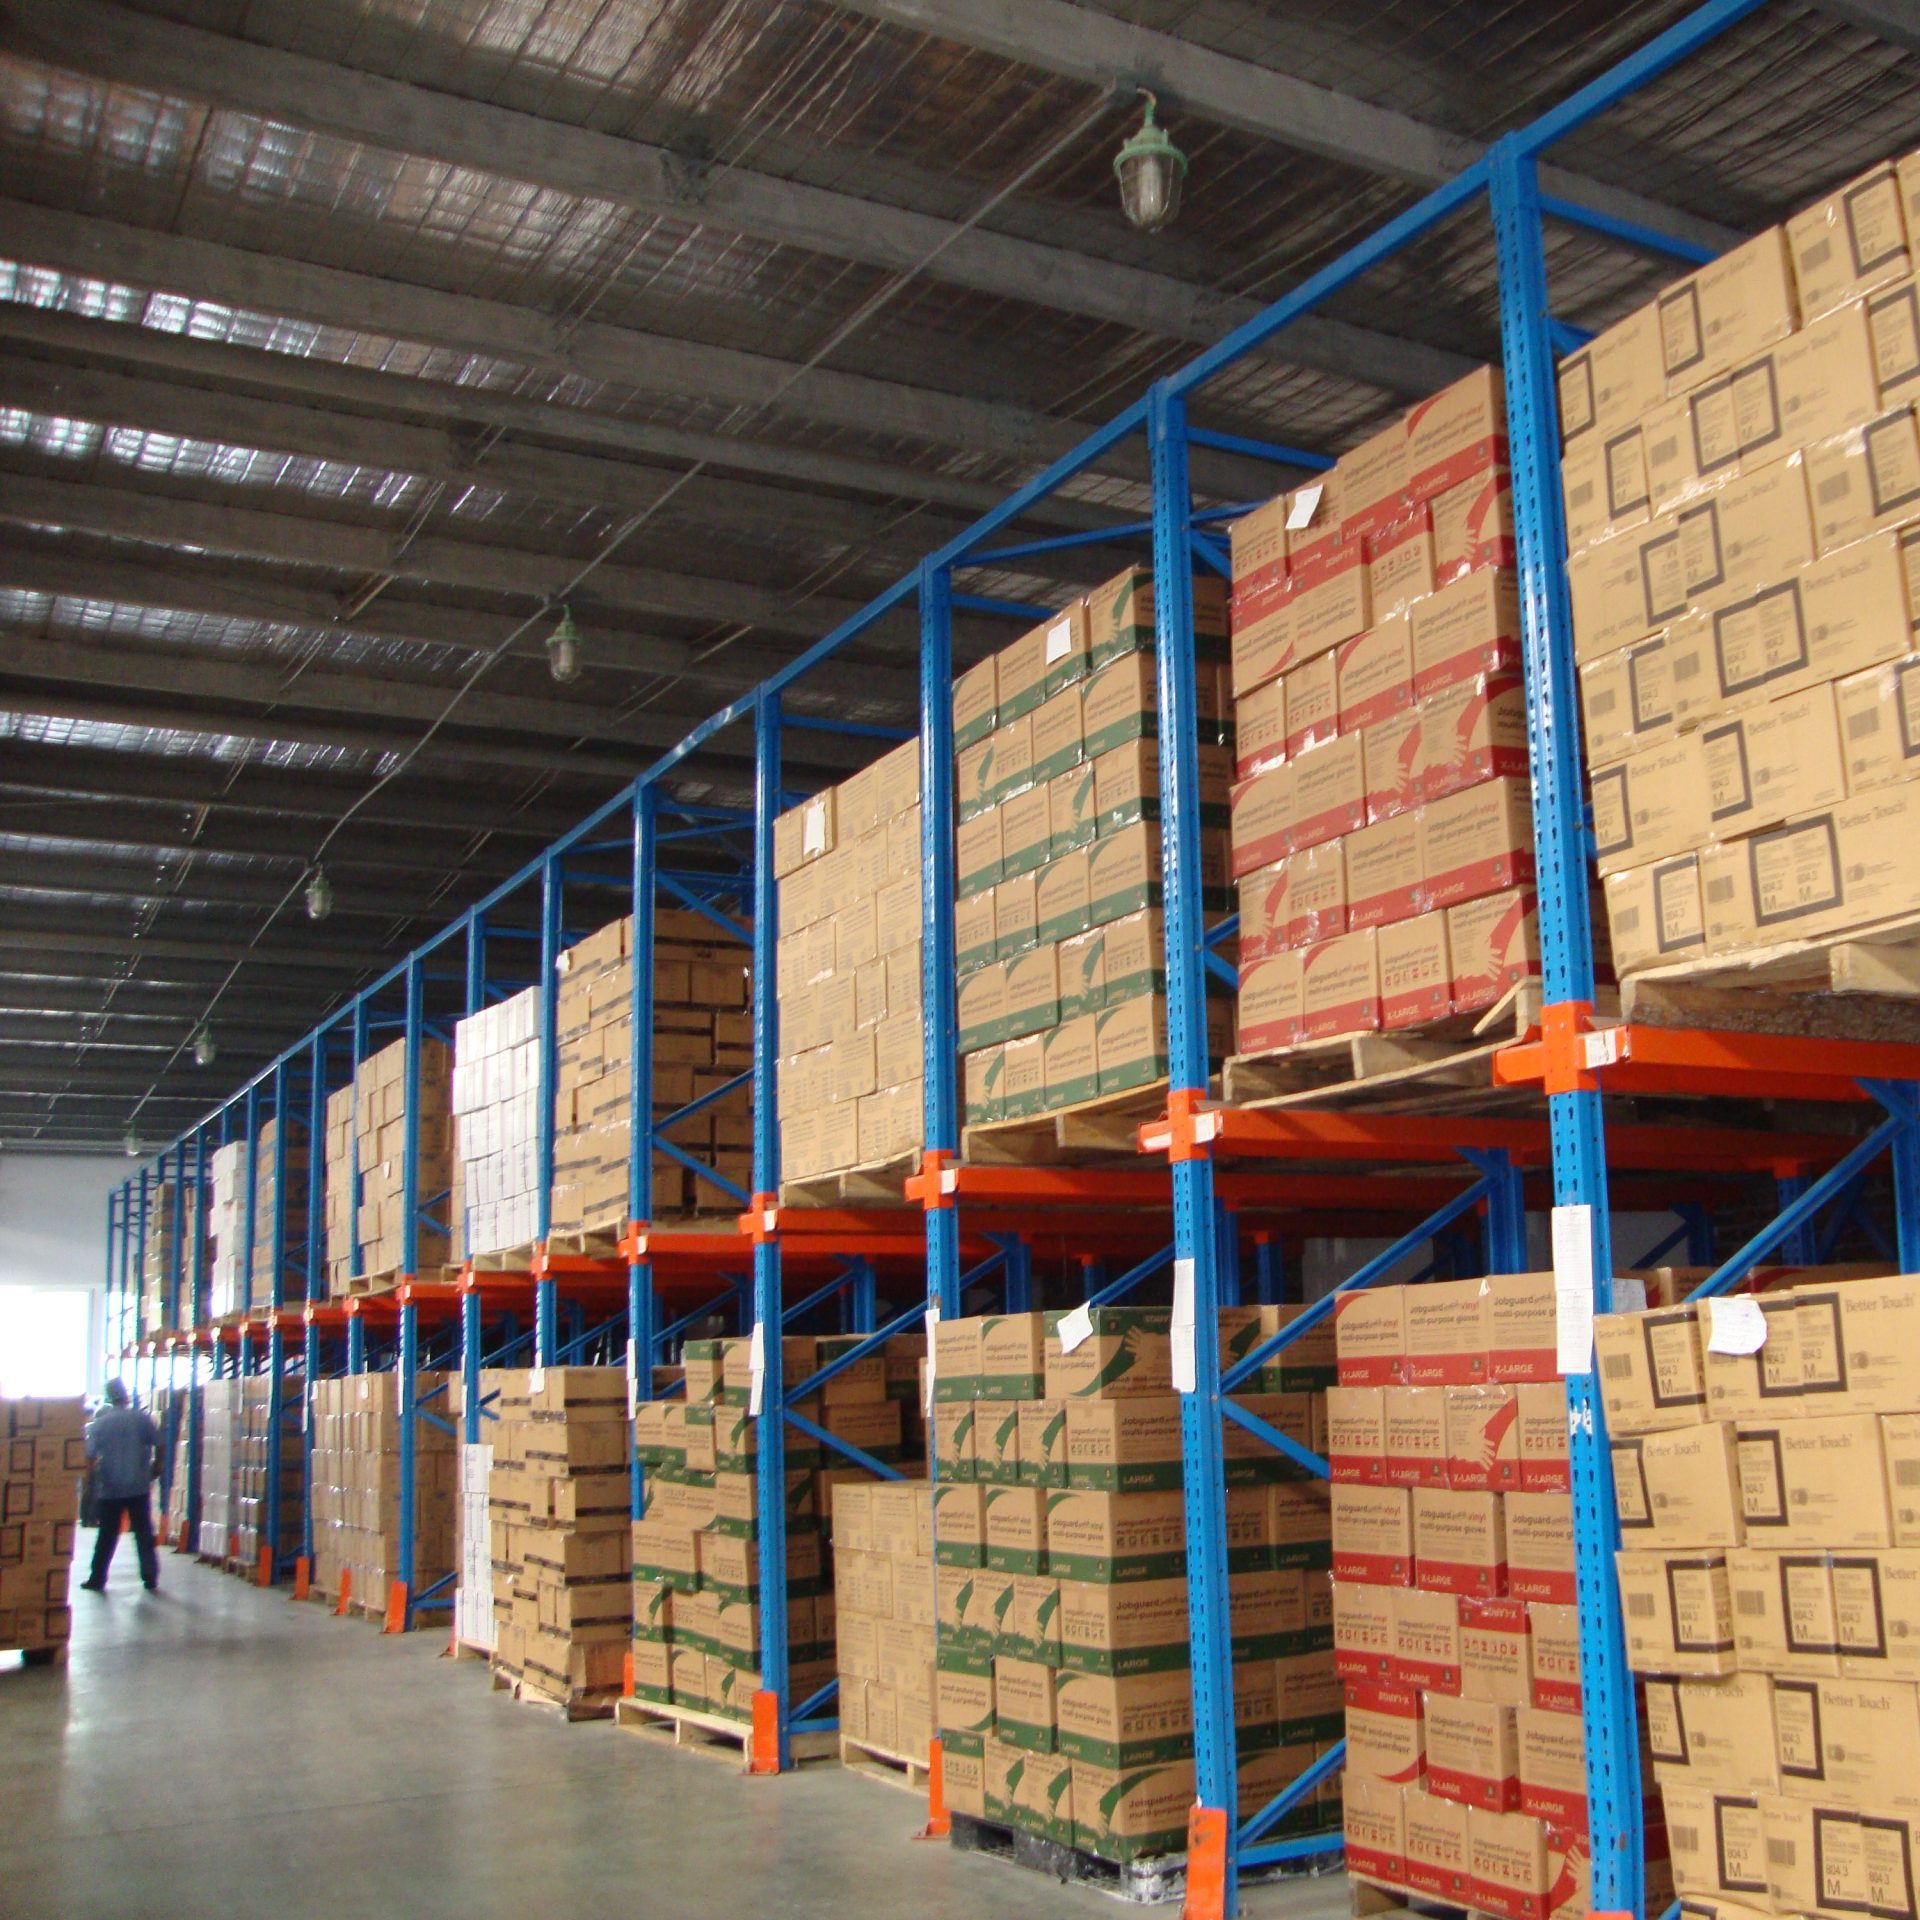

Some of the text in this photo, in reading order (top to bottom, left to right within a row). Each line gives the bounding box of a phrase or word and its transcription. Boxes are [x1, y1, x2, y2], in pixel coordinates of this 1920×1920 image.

[1413, 1368, 1444, 1378] X-LARGE
[1495, 1363, 1534, 1374] X-LARGE
[1342, 1369, 1369, 1379] X-LARGE
[1526, 1474, 1564, 1484] X-LARGE
[1337, 1565, 1368, 1575] X-LARGE
[1421, 1575, 1452, 1585] X-LARGE
[1513, 1582, 1551, 1595] X-LARGE
